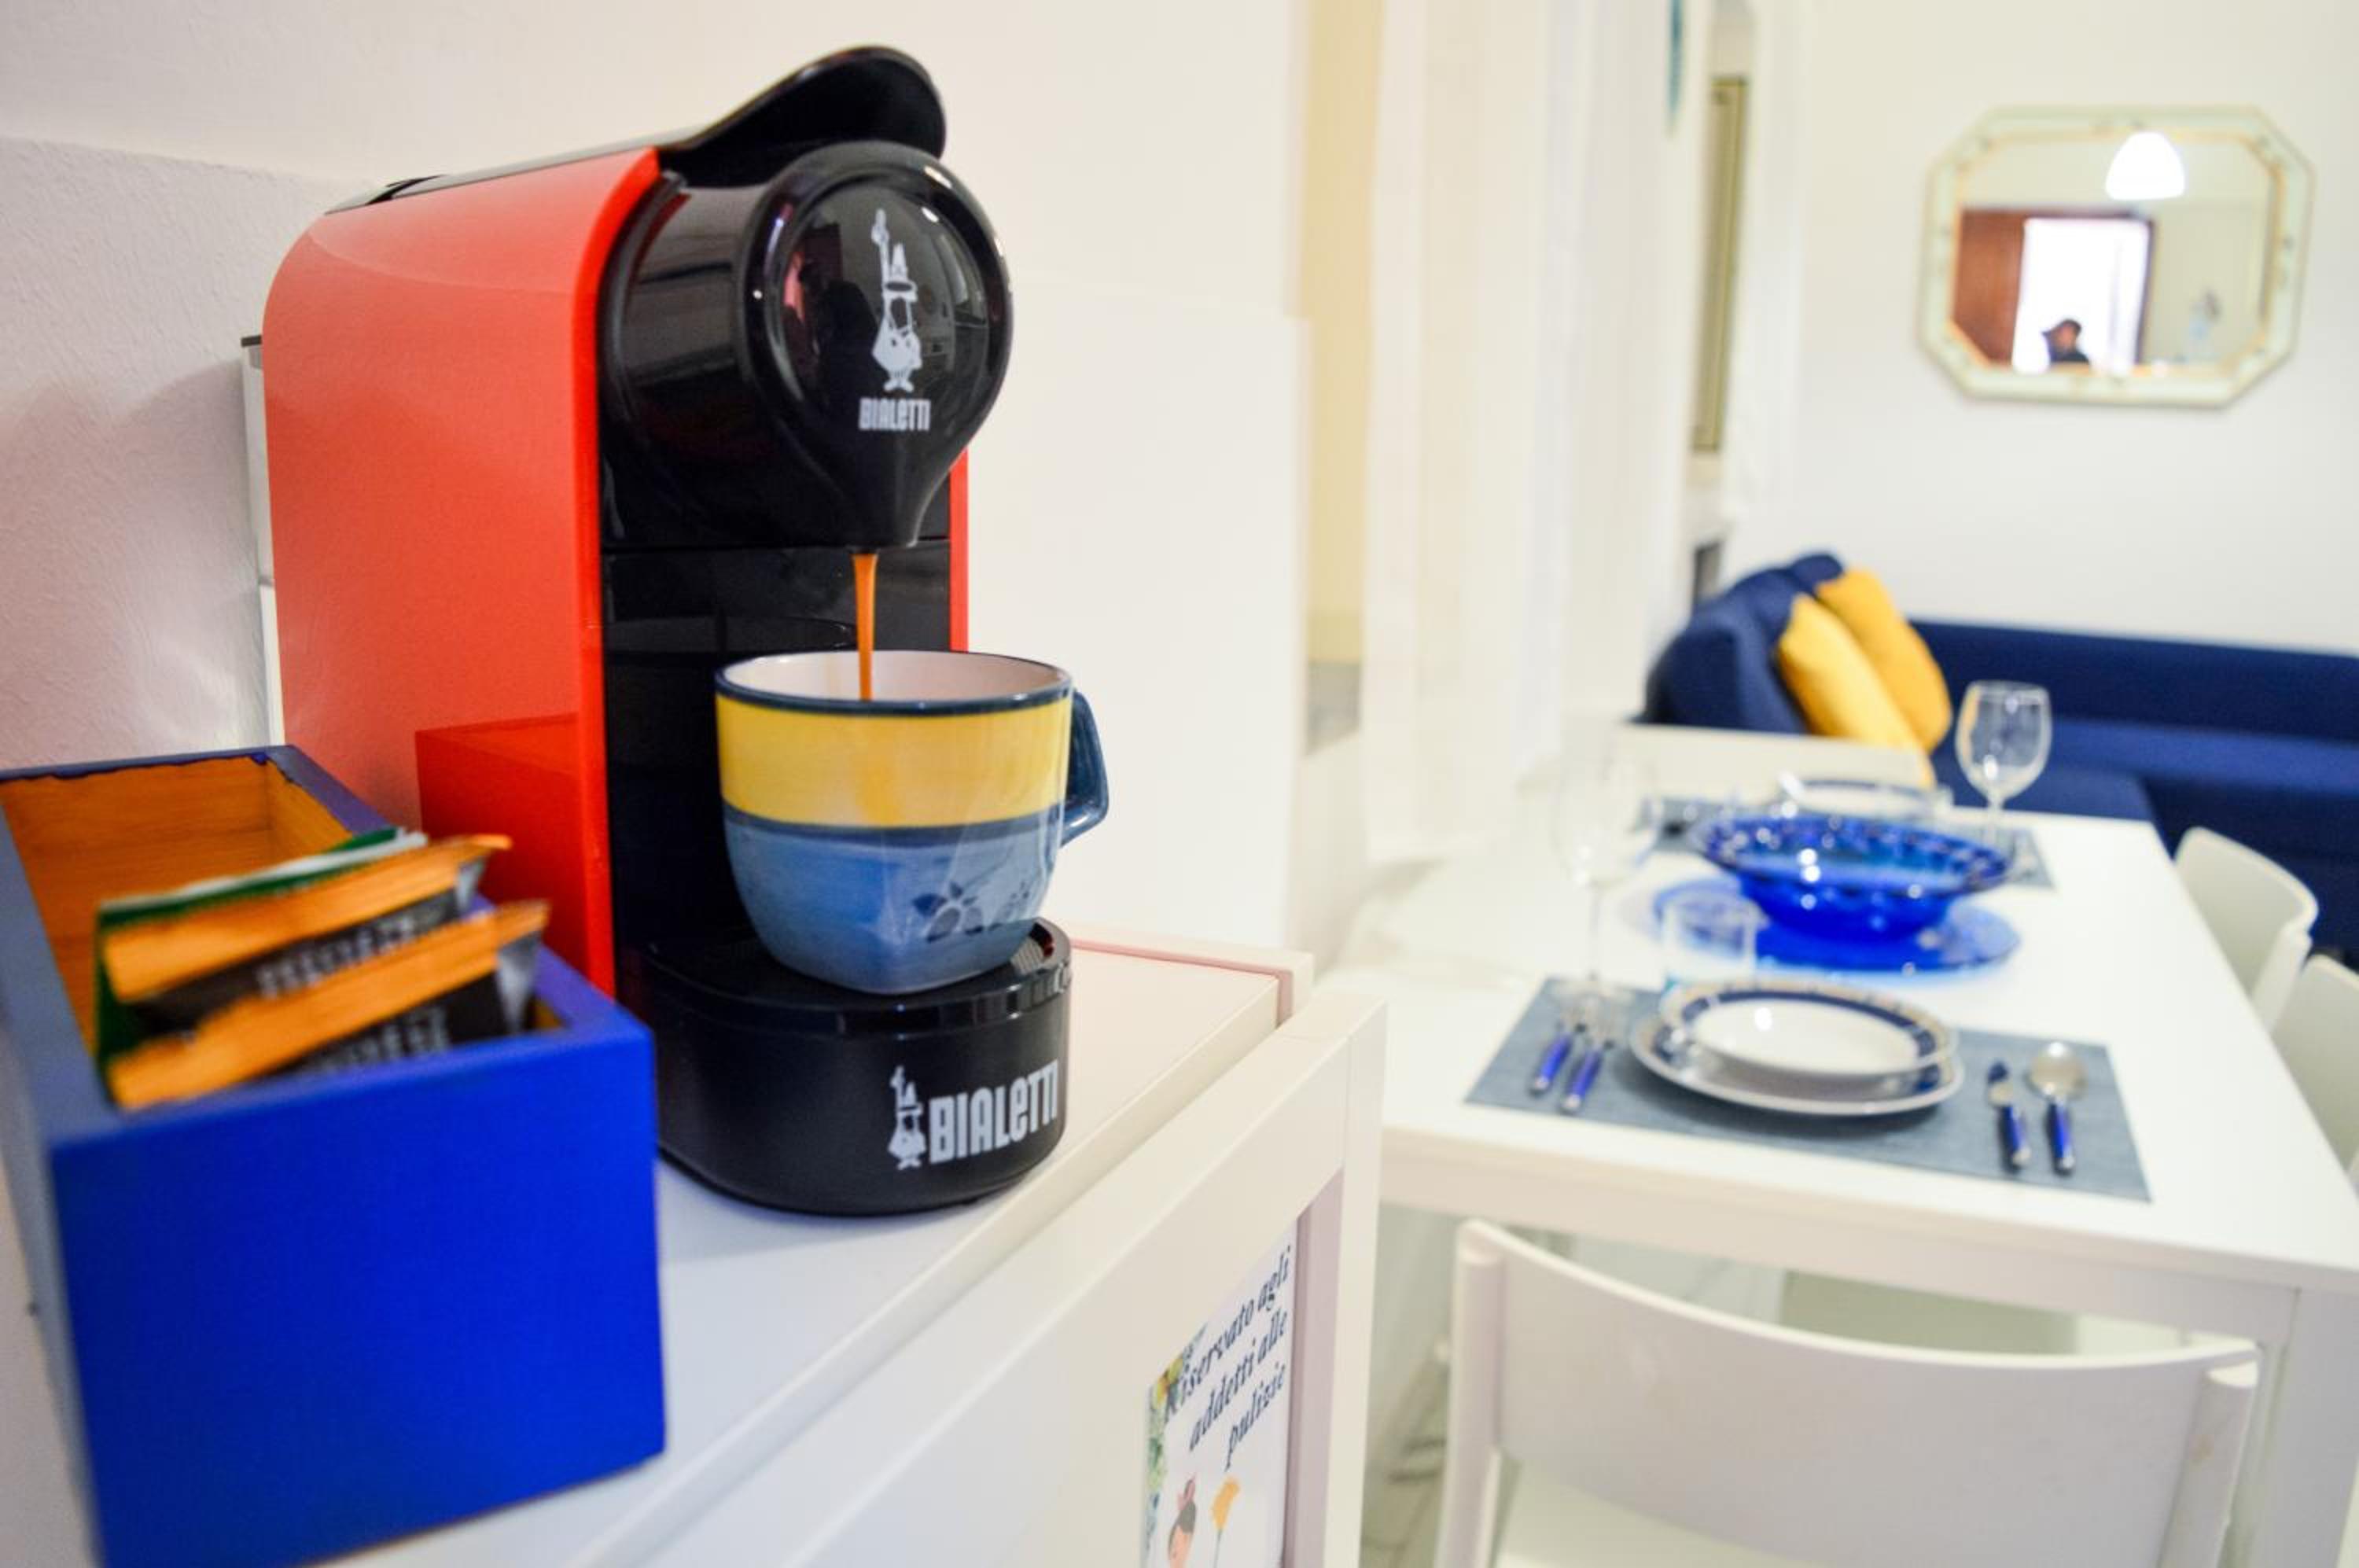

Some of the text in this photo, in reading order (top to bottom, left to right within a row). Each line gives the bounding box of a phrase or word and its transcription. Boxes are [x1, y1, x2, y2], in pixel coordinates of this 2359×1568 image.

[929, 1059, 1058, 1164] BIALETTI
[1257, 1245, 1290, 1312] agli
[1189, 1309, 1288, 1452] addetti alle
[1224, 1362, 1286, 1471] pulizie
